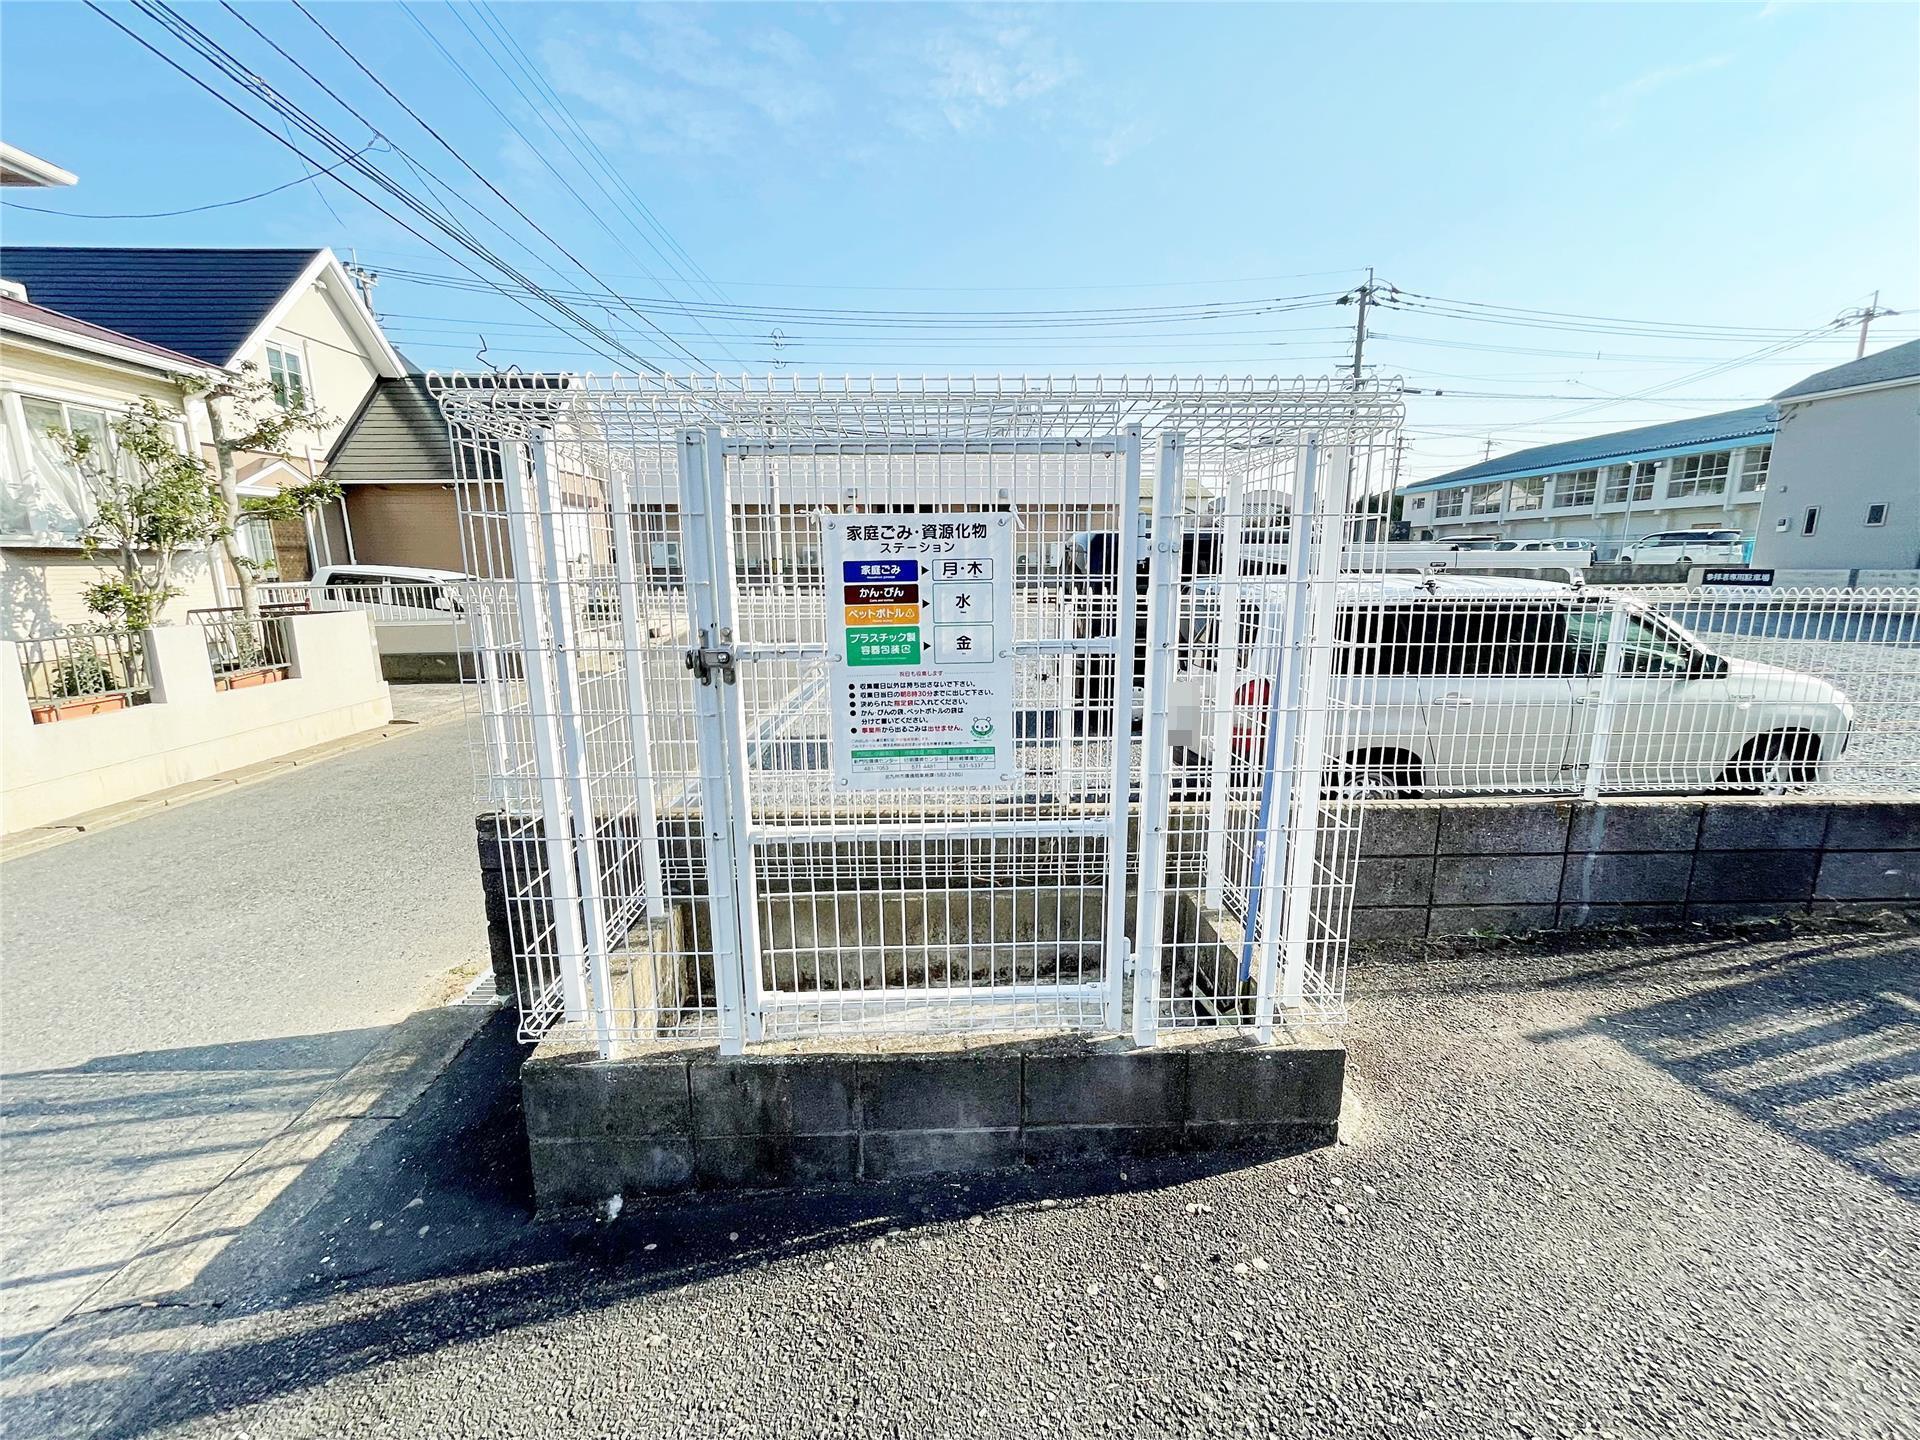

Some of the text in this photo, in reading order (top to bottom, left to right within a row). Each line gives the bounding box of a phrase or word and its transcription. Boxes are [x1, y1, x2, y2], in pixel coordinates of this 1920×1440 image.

[846, 523, 987, 541] 家庭ごみ・資源化物
[880, 542, 955, 553] ステーション
[860, 564, 901, 575] 家庭ごみ
[942, 561, 983, 576] 月・木
[859, 587, 904, 598] かん・びん
[955, 593, 971, 609] 水
[848, 608, 905, 618] ペットボトル
[850, 632, 916, 643] プラスチック製
[956, 635, 972, 651] 金
[860, 645, 900, 655] 容器包装
